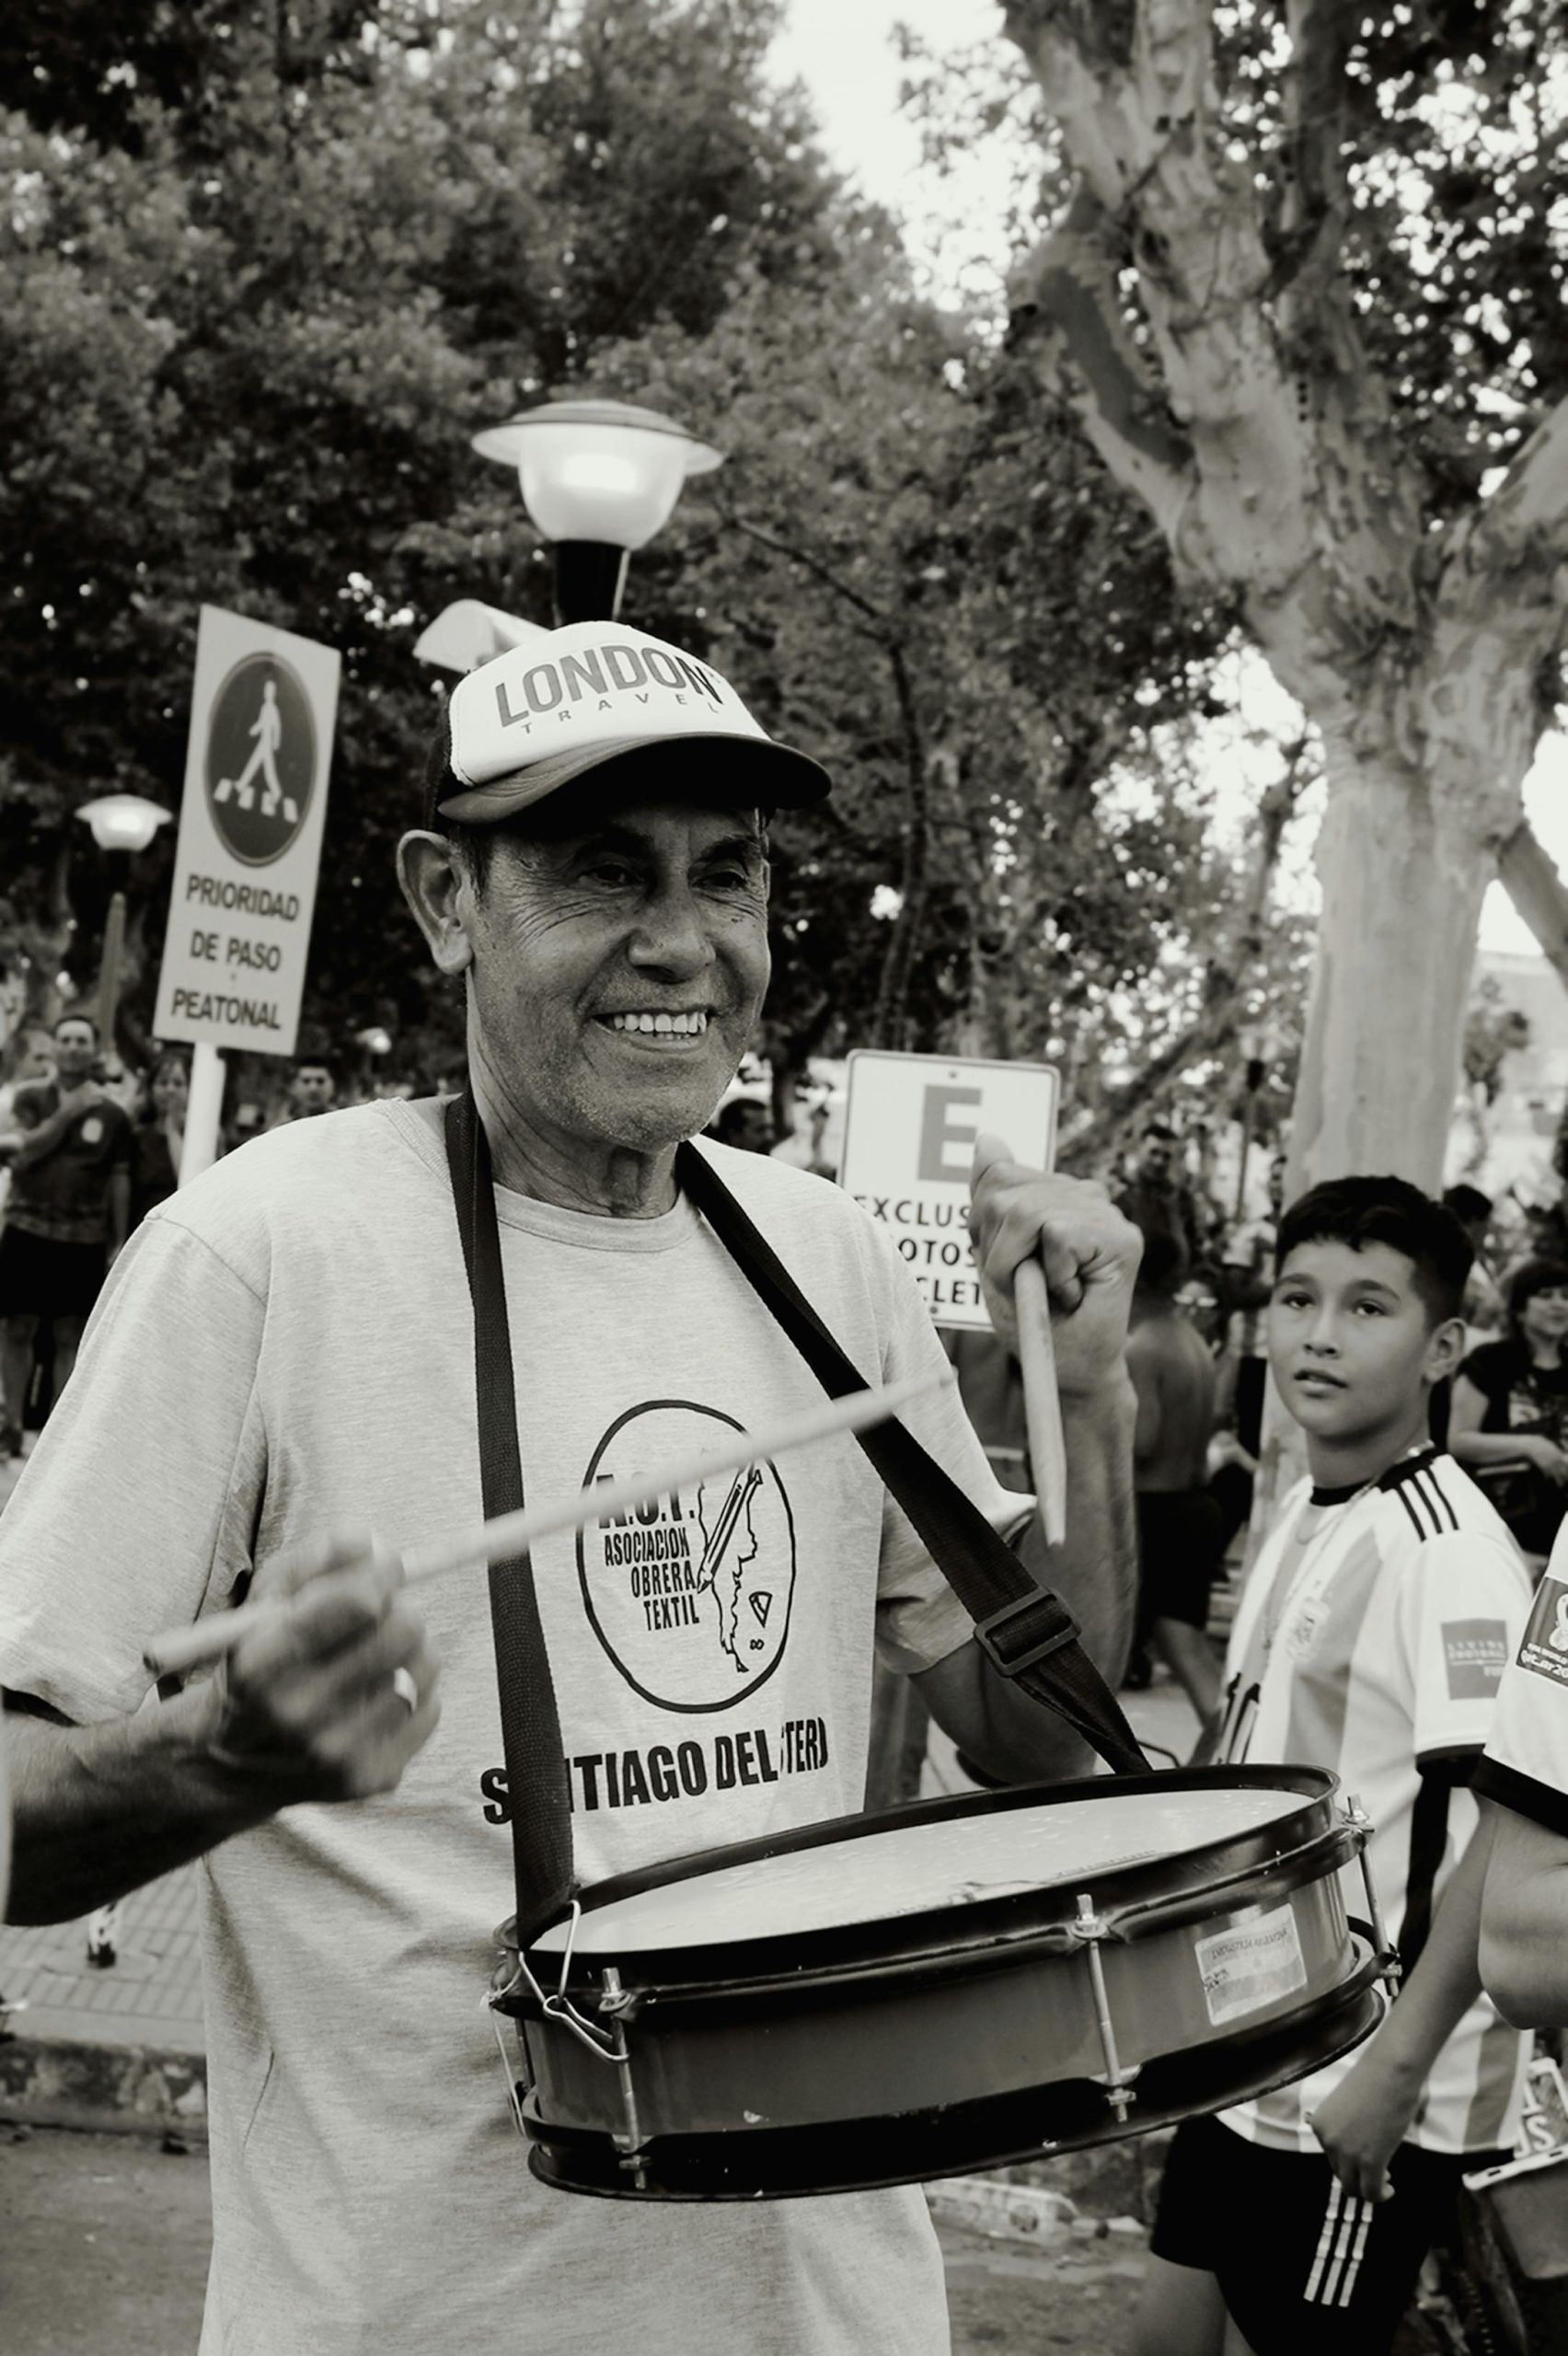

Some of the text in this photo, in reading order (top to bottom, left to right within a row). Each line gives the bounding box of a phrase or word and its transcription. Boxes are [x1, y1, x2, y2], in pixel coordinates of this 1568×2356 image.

[495, 645, 724, 728] LONDON
[521, 693, 720, 734] TRAVEL
[185, 873, 300, 922] PRIORIDAD
[190, 930, 282, 972] DE PASO
[170, 987, 281, 1031] PEATONAL
[917, 1084, 983, 1184] E
[898, 1238, 977, 1268] OTOS
[604, 1527, 691, 1566] ASOCIACION
[630, 1560, 697, 1599] OBRERA
[643, 1594, 700, 1632] TEXTIL
[480, 1740, 709, 1825] STIAGO
[715, 1729, 778, 1791] DEL
